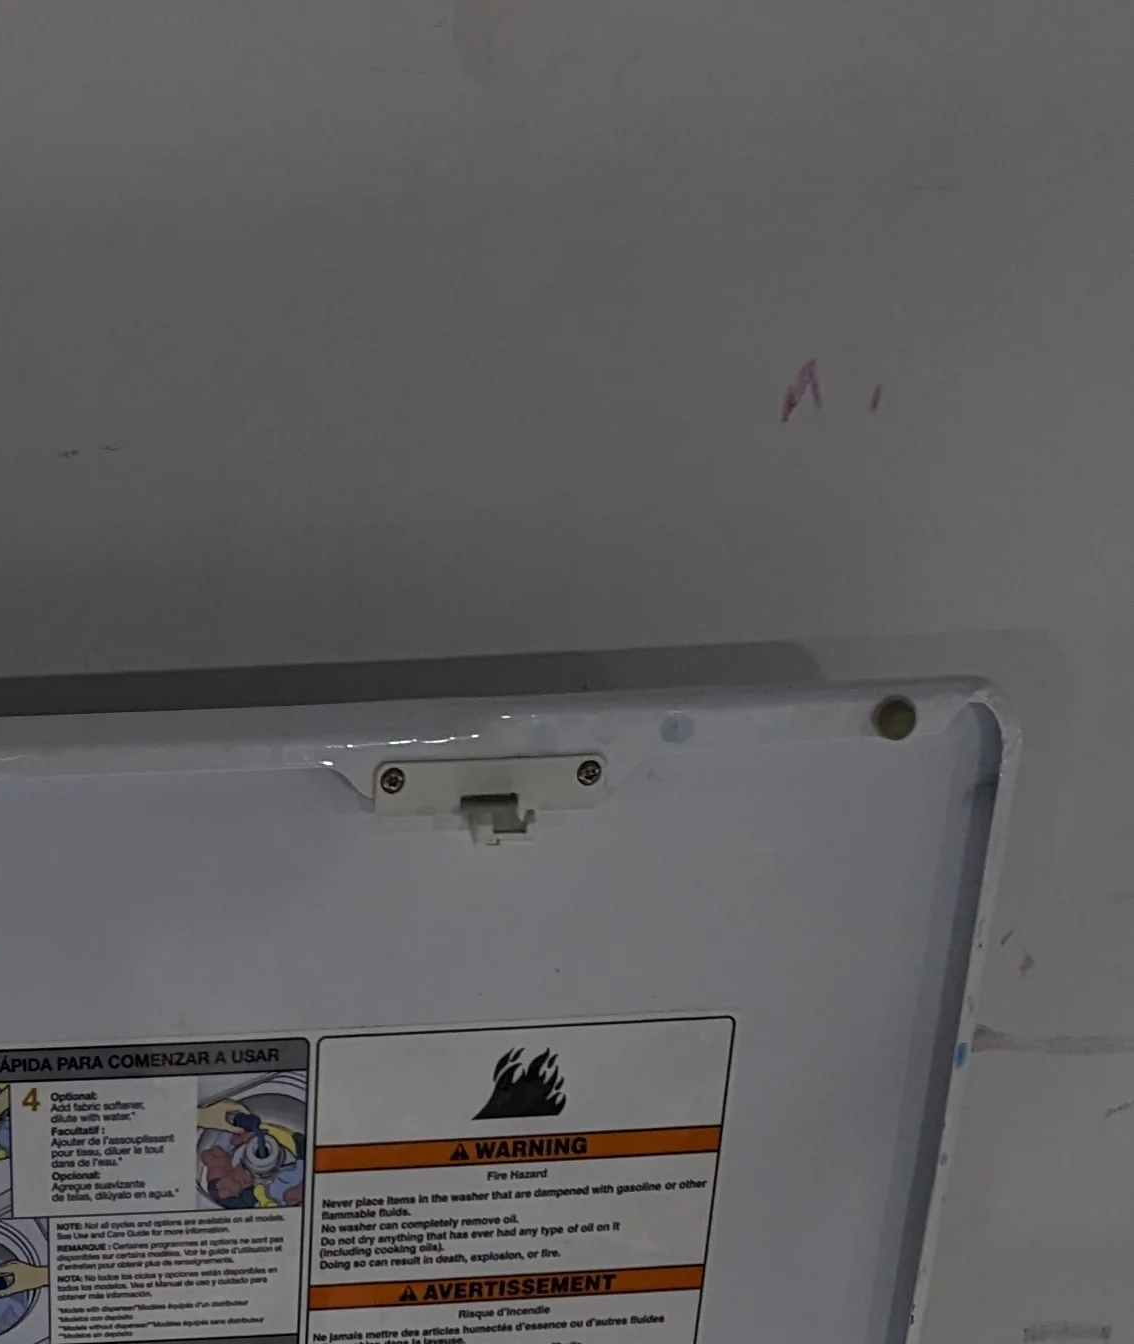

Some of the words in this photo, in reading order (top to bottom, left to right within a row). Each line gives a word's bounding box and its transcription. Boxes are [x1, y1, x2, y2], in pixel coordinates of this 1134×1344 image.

[57, 1055, 102, 1070] PARA
[108, 1051, 208, 1068] COMENZAR
[214, 1051, 226, 1064] A
[232, 1048, 278, 1063] USAR
[22, 1087, 39, 1111] 4
[474, 1136, 588, 1159] WARNING
[486, 1170, 508, 1180] Fire
[509, 1168, 548, 1179] Hazard
[321, 1198, 353, 1208] Never
[354, 1196, 384, 1208] place
[386, 1195, 416, 1205] items
[417, 1194, 429, 1203] in
[430, 1193, 448, 1203] the
[450, 1191, 489, 1202] washer
[491, 1190, 512, 1199] that
[514, 1190, 532, 1198] are
[533, 1185, 590, 1198] dampened
[591, 1184, 614, 1194] with
[615, 1181, 662, 1194] gasoline
[664, 1181, 677, 1190] or
[677, 1178, 708, 1189] other
[320, 1223, 336, 1233] No
[338, 1222, 377, 1232] washer
[378, 1222, 398, 1230] can
[400, 1217, 459, 1231] completely
[460, 1217, 501, 1226] remove
[502, 1214, 518, 1224] oil.
[321, 1209, 376, 1220] flammable
[378, 1207, 411, 1217] fluids.
[320, 1236, 336, 1246] Do
[337, 1236, 356, 1245] not
[357, 1234, 375, 1245] dry
[377, 1232, 424, 1244] anything
[425, 1231, 447, 1240] that
[448, 1229, 469, 1239] has
[470, 1230, 494, 1238] ever
[495, 1227, 517, 1237] had
[518, 1227, 538, 1237] any
[540, 1225, 564, 1236] type
[566, 1223, 579, 1233] of
[580, 1223, 594, 1232] oil
[595, 1223, 610, 1231] on
[611, 1221, 621, 1231] it
[318, 1246, 372, 1259] (including
[373, 1244, 417, 1256] cooking
[418, 1242, 444, 1253] oils).
[319, 1259, 351, 1271] Doing
[368, 1259, 388, 1267] can
[390, 1256, 421, 1266] result
[422, 1255, 433, 1264] in
[435, 1253, 467, 1264] death,
[470, 1250, 524, 1263] explosion,
[526, 1250, 539, 1258] or
[540, 1248, 561, 1257] fire.
[423, 1274, 616, 1300] AVERTISSEMENT
[457, 1308, 494, 1320] Risque
[496, 1305, 551, 1316] d'incendie
